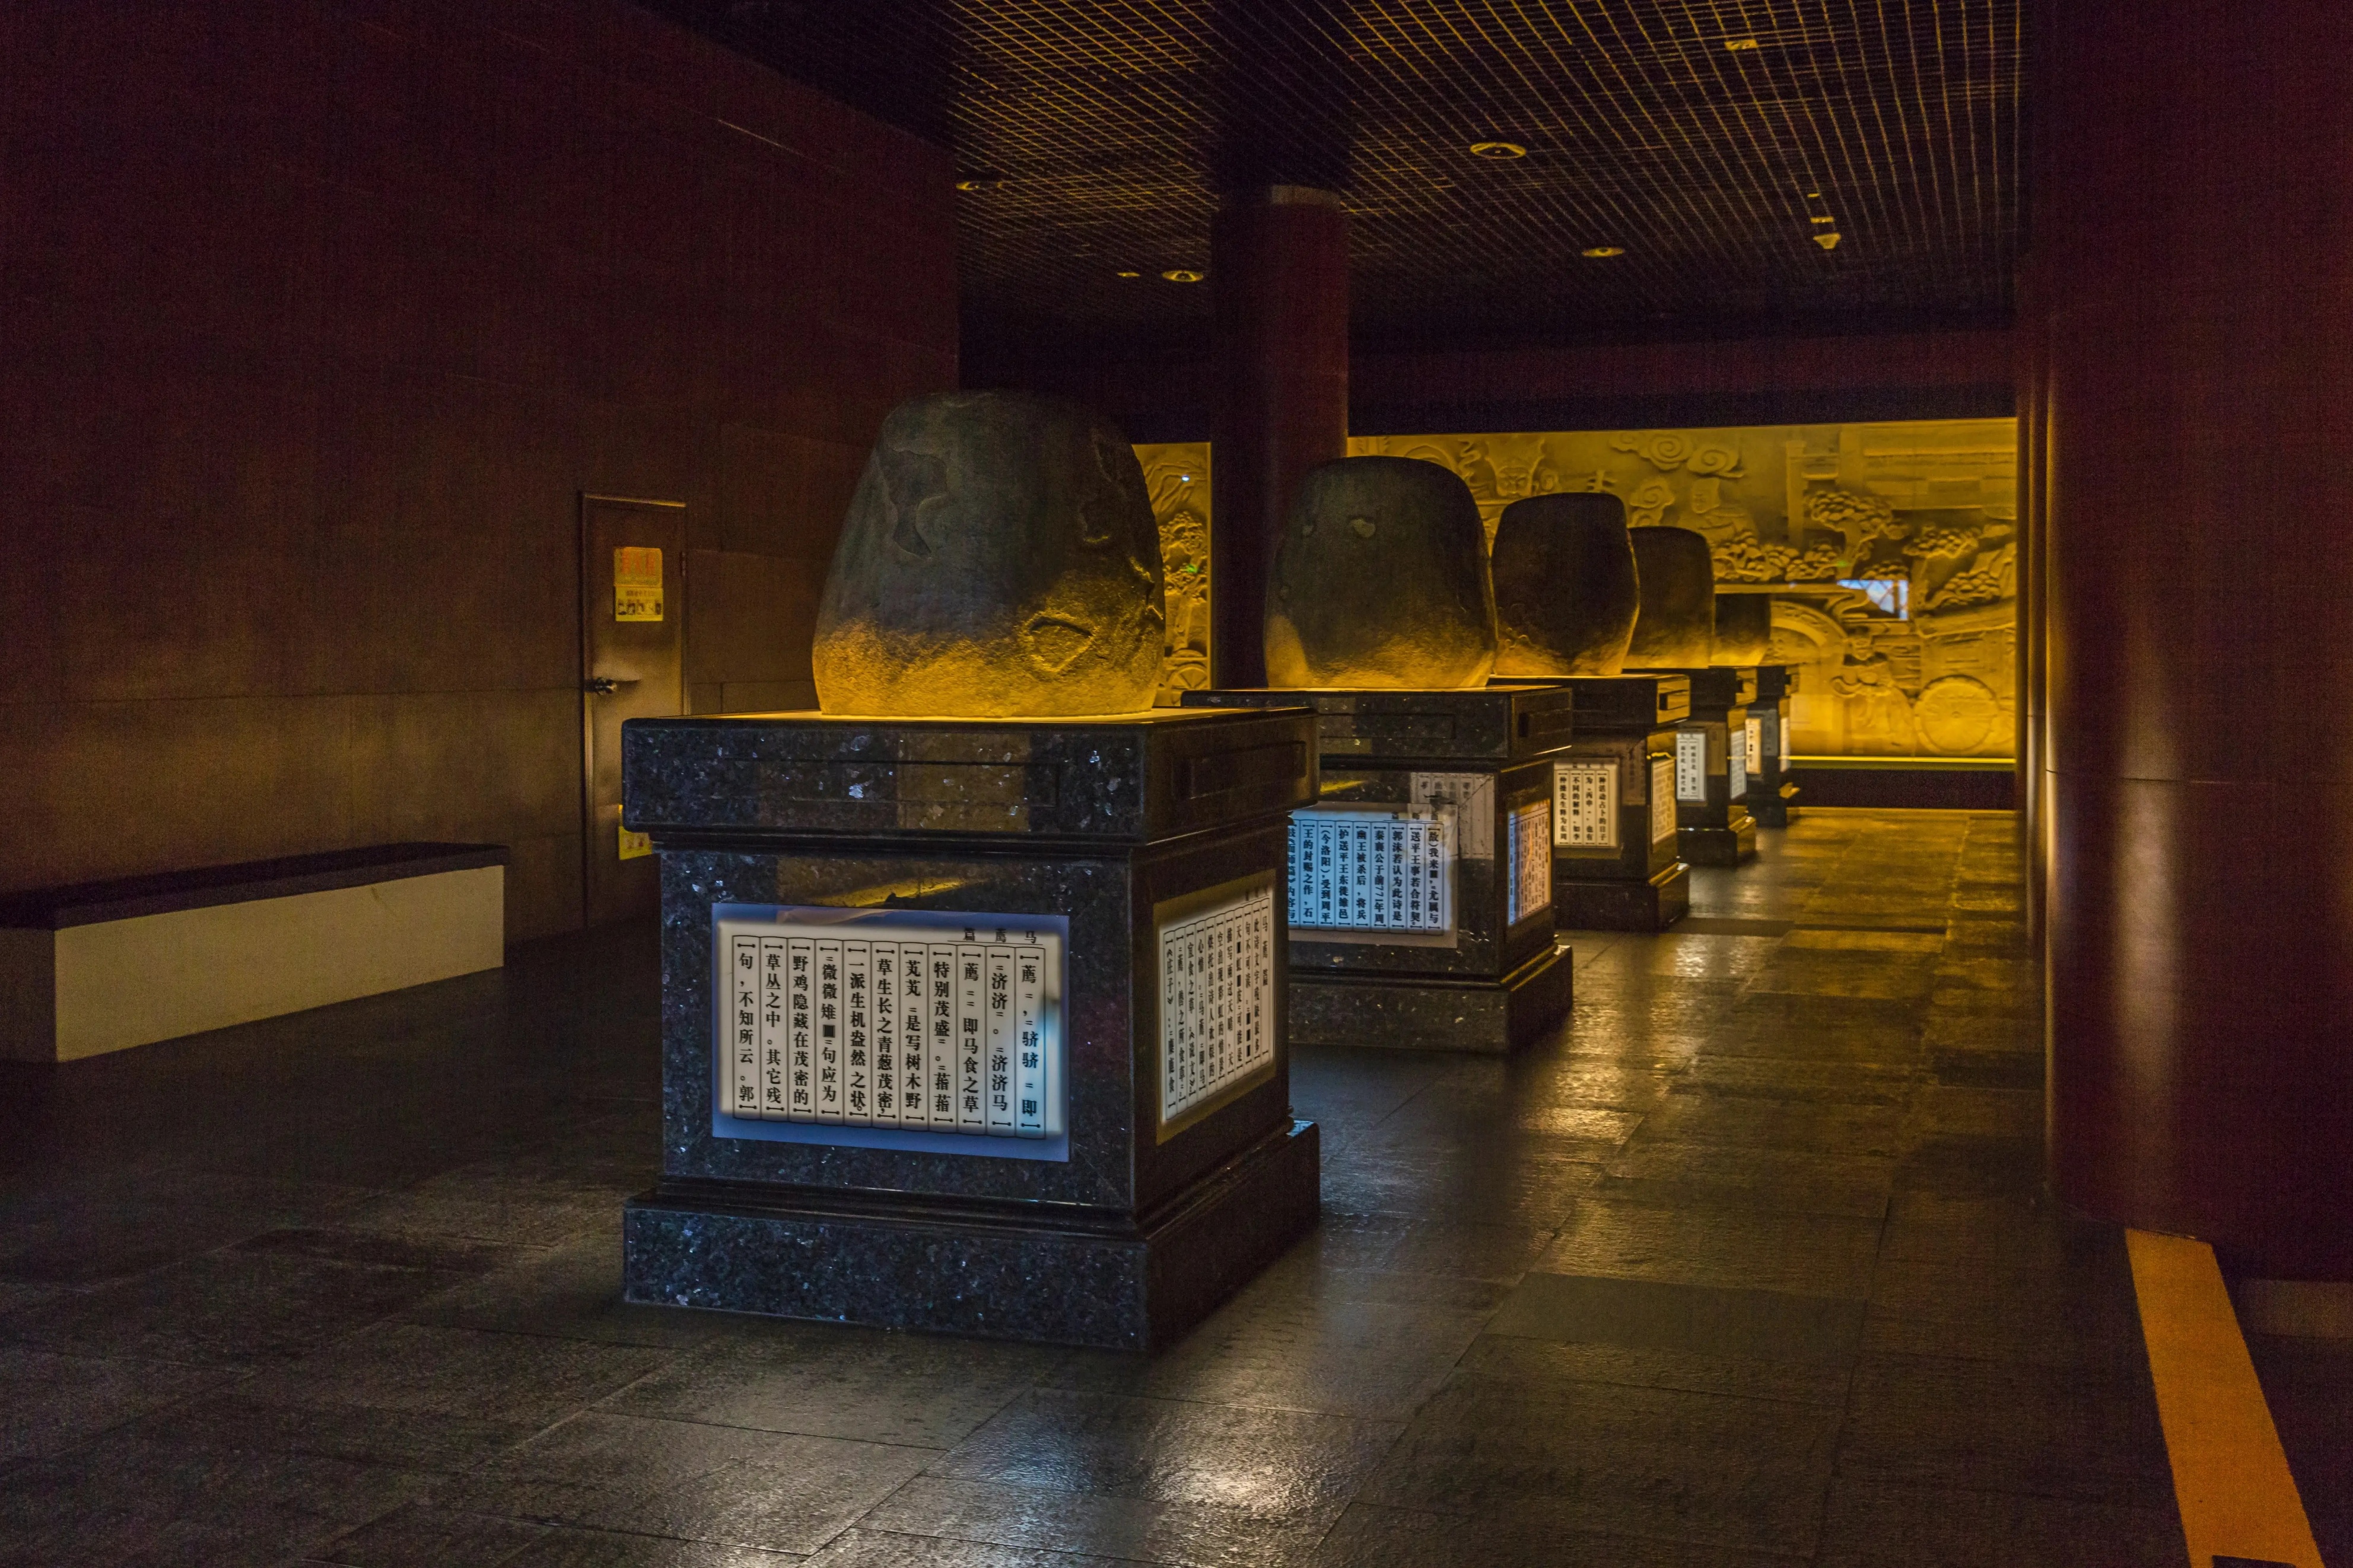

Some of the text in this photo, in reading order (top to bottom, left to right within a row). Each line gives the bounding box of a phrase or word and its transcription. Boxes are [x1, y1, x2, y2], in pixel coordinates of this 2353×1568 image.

[1392, 831, 1403, 921] 郭沫若认为此诗是
[738, 953, 755, 1102] 句，不知所云。郭
[765, 953, 782, 1104] 草丛之中。其它残
[793, 955, 809, 1105] 野鸡隐藏在茂密的
[848, 962, 866, 1111] 一派生机盎然之状。
[876, 958, 893, 1114] 草生长之青葱茂密，
